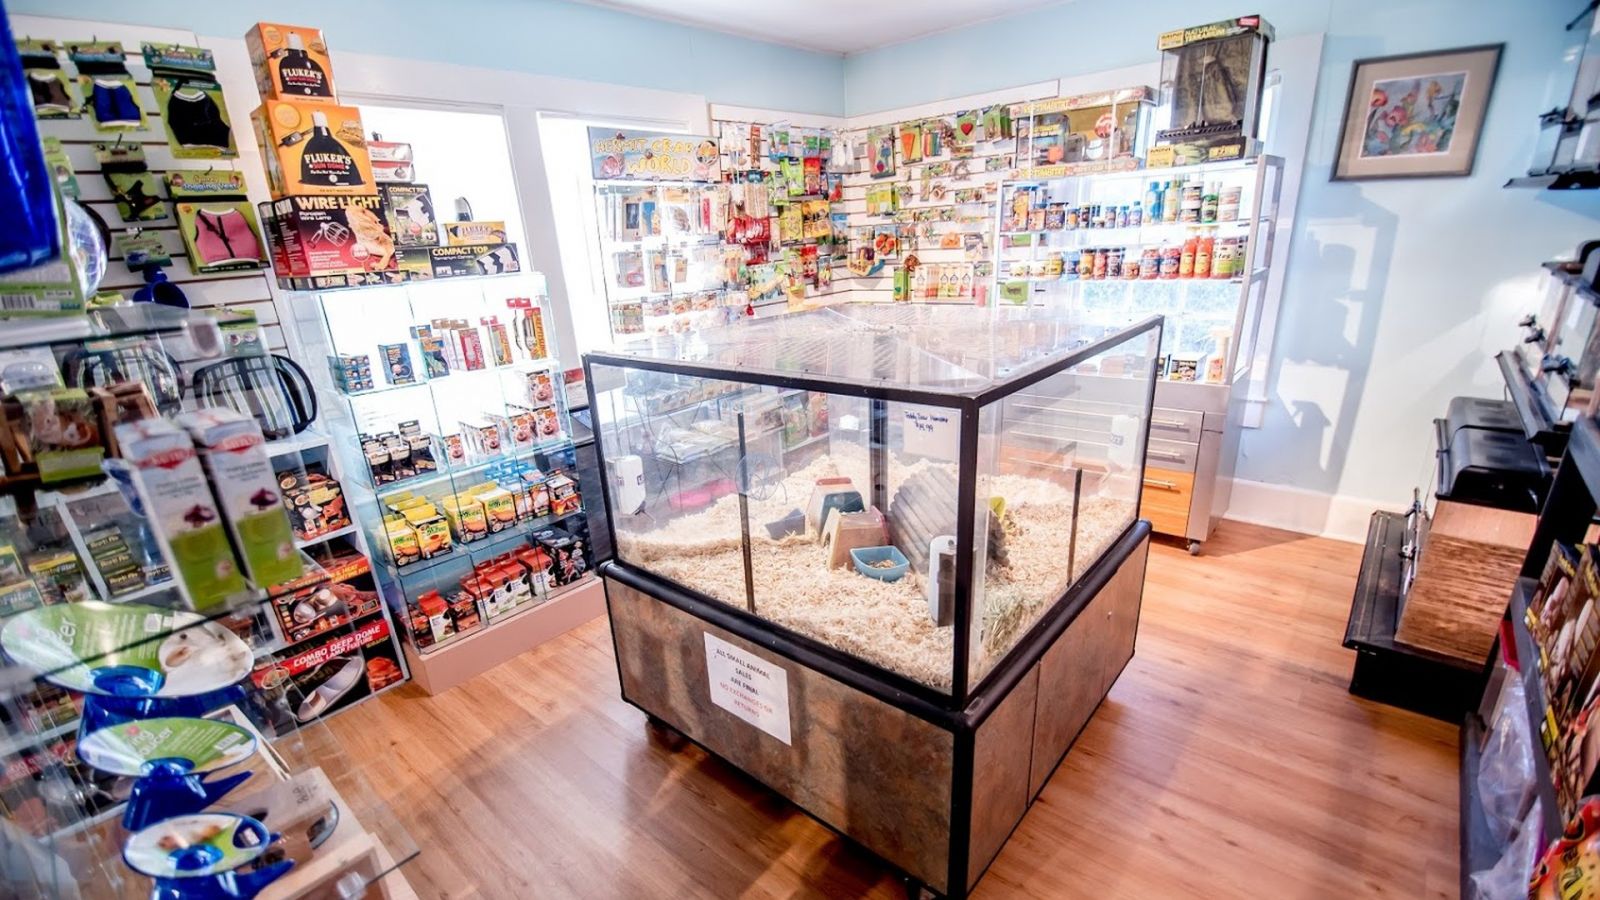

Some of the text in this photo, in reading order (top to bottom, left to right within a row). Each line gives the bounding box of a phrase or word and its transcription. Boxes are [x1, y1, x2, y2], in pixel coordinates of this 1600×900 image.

[282, 68, 322, 80] FLUKER'S
[595, 137, 694, 154] HERMIT CRAB
[304, 153, 351, 165] FLUKER'S
[627, 154, 691, 175] WORLD
[295, 196, 381, 211] WIRE LIGHT
[432, 246, 489, 257] COMPACT TOP
[293, 647, 328, 667] COMBO
[330, 637, 354, 652] DEEP
[355, 625, 381, 640] DOME
[716, 648, 727, 658] ALL
[726, 653, 746, 667] SMALL
[735, 667, 752, 681] SALES
[720, 682, 729, 692] NO
[730, 676, 760, 696] ARE FINAL
